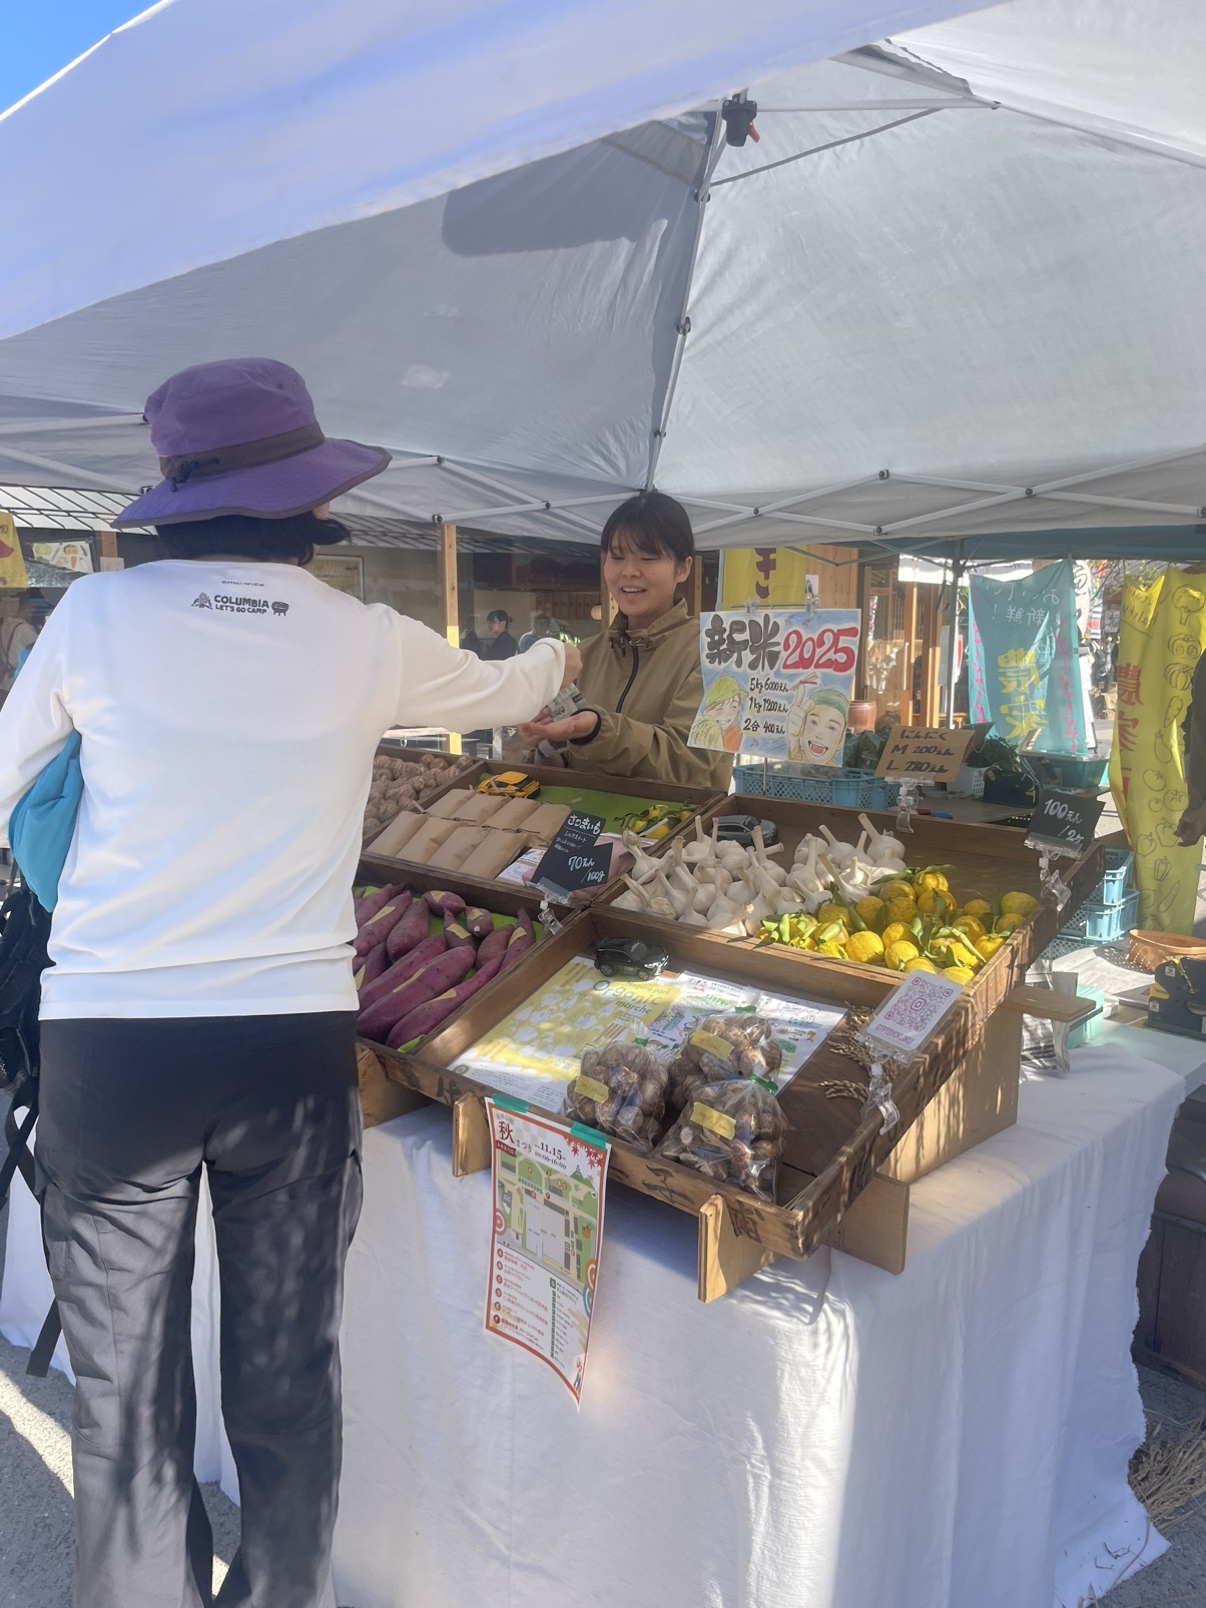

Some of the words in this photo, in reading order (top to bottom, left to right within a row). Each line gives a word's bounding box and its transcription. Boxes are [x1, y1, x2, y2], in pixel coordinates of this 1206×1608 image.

[214, 595, 269, 608] COLUMBIA
[215, 604, 235, 612] LET'S
[705, 613, 782, 672] 新米
[782, 626, 859, 673] 2025
[749, 677, 764, 694] 5kg
[764, 681, 790, 693] 6000えん
[748, 696, 763, 714] 1kg
[763, 698, 789, 714] 1200えん
[743, 718, 761, 732] 2合
[763, 720, 786, 735] 400えん
[900, 729, 949, 741] にんにく
[890, 744, 909, 754] M
[912, 745, 955, 756] 200えん
[886, 760, 899, 770] L
[904, 761, 949, 773] 280えん
[1044, 799, 1083, 824] 100えん
[567, 814, 601, 835] さつまいも
[568, 856, 595, 871] 70えん
[592, 979, 664, 1006] Organic
[615, 1000, 654, 1015] marche
[540, 1142, 562, 1161] 11.15
